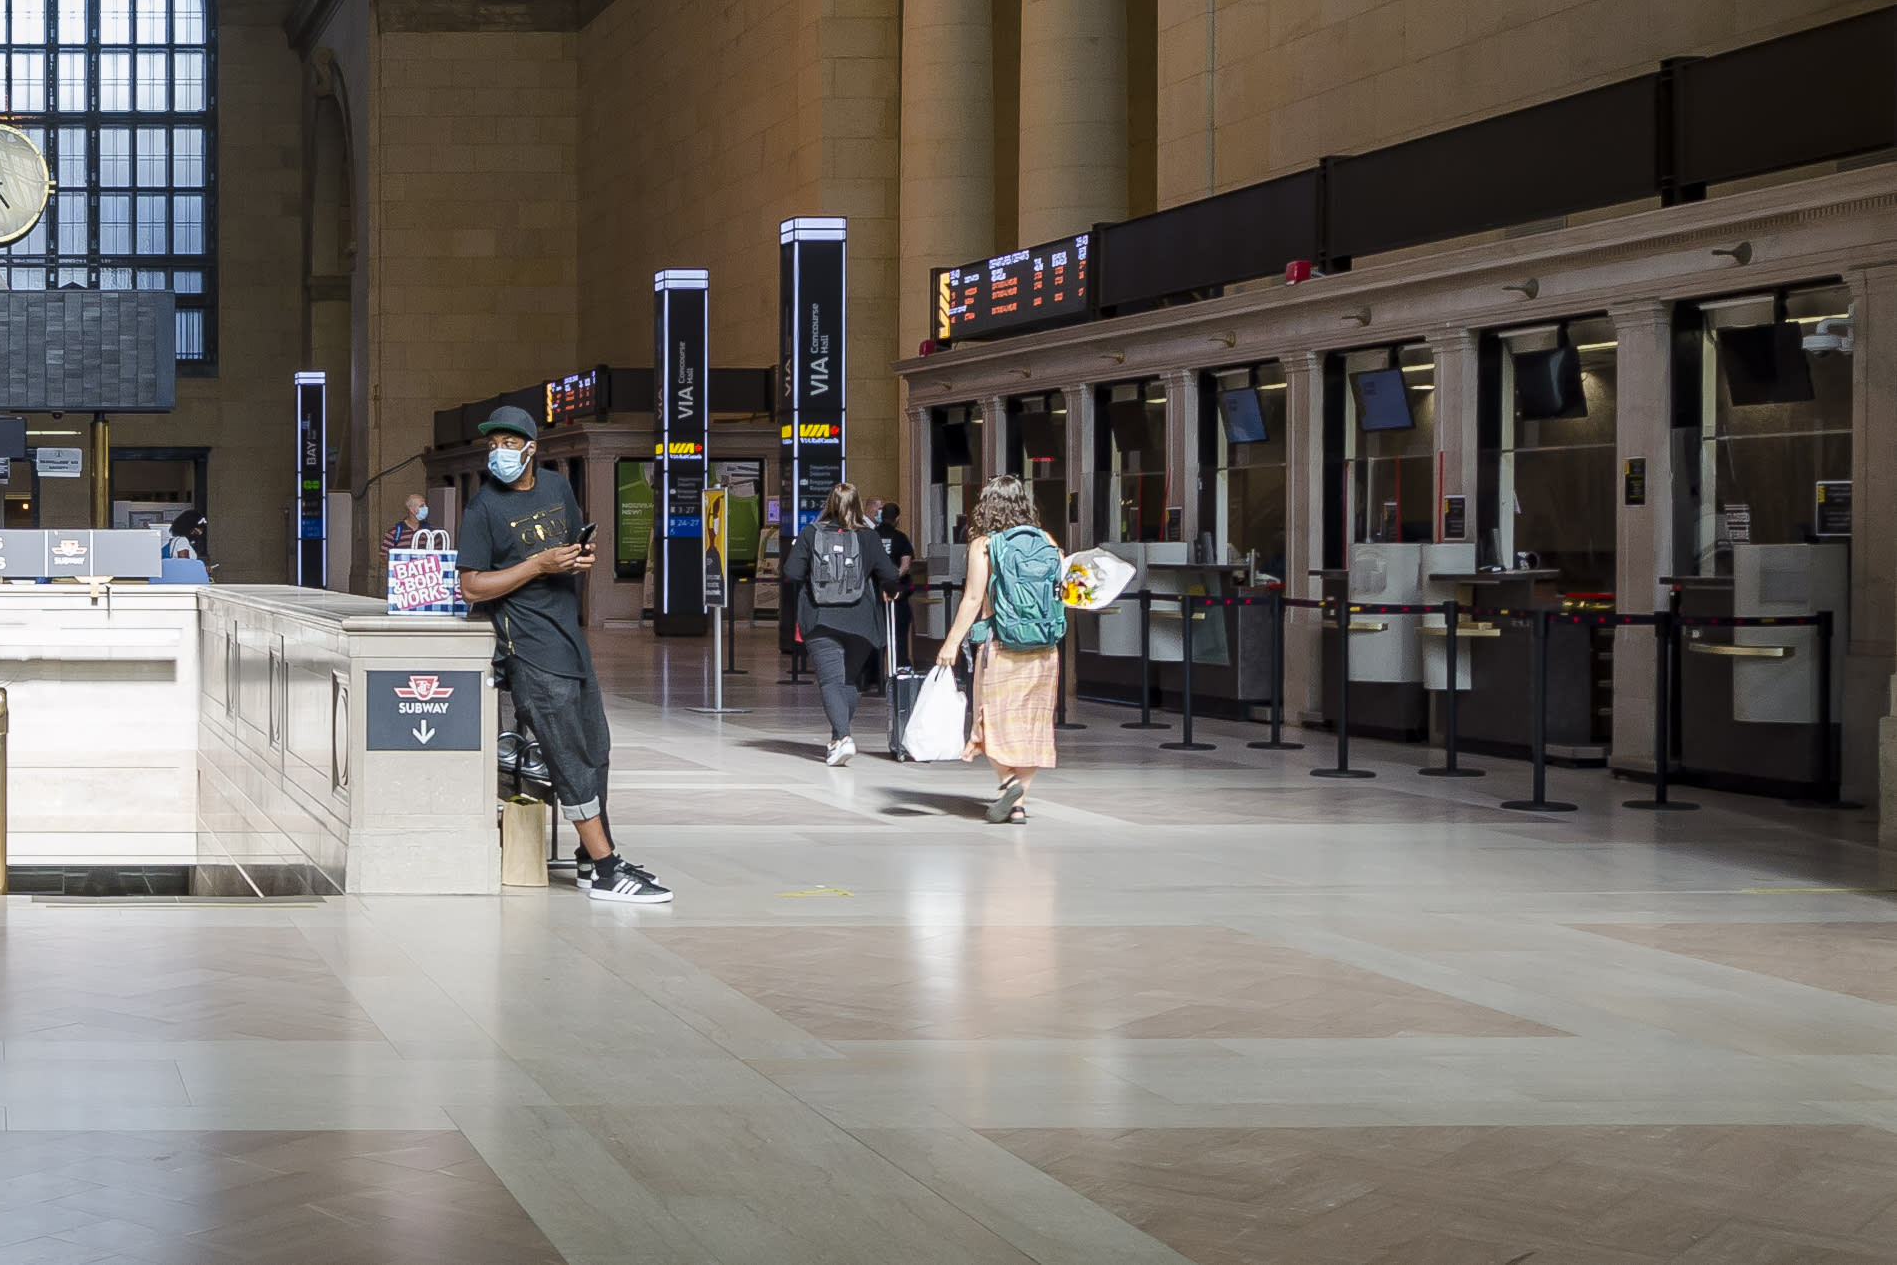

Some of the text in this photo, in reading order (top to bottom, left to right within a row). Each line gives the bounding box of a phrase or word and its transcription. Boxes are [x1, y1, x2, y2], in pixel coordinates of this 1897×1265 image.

[810, 303, 819, 354] Concourse
[821, 335, 829, 354] Hall
[678, 341, 686, 383] Concourse
[810, 357, 829, 396] VIA
[678, 387, 694, 420] VIA
[800, 424, 830, 438] VIA
[306, 441, 317, 465] BAY
[54, 557, 85, 565] SUBWAY
[395, 558, 436, 581] BATH
[396, 585, 450, 610] WORKS
[398, 702, 449, 714] SUBWAY
